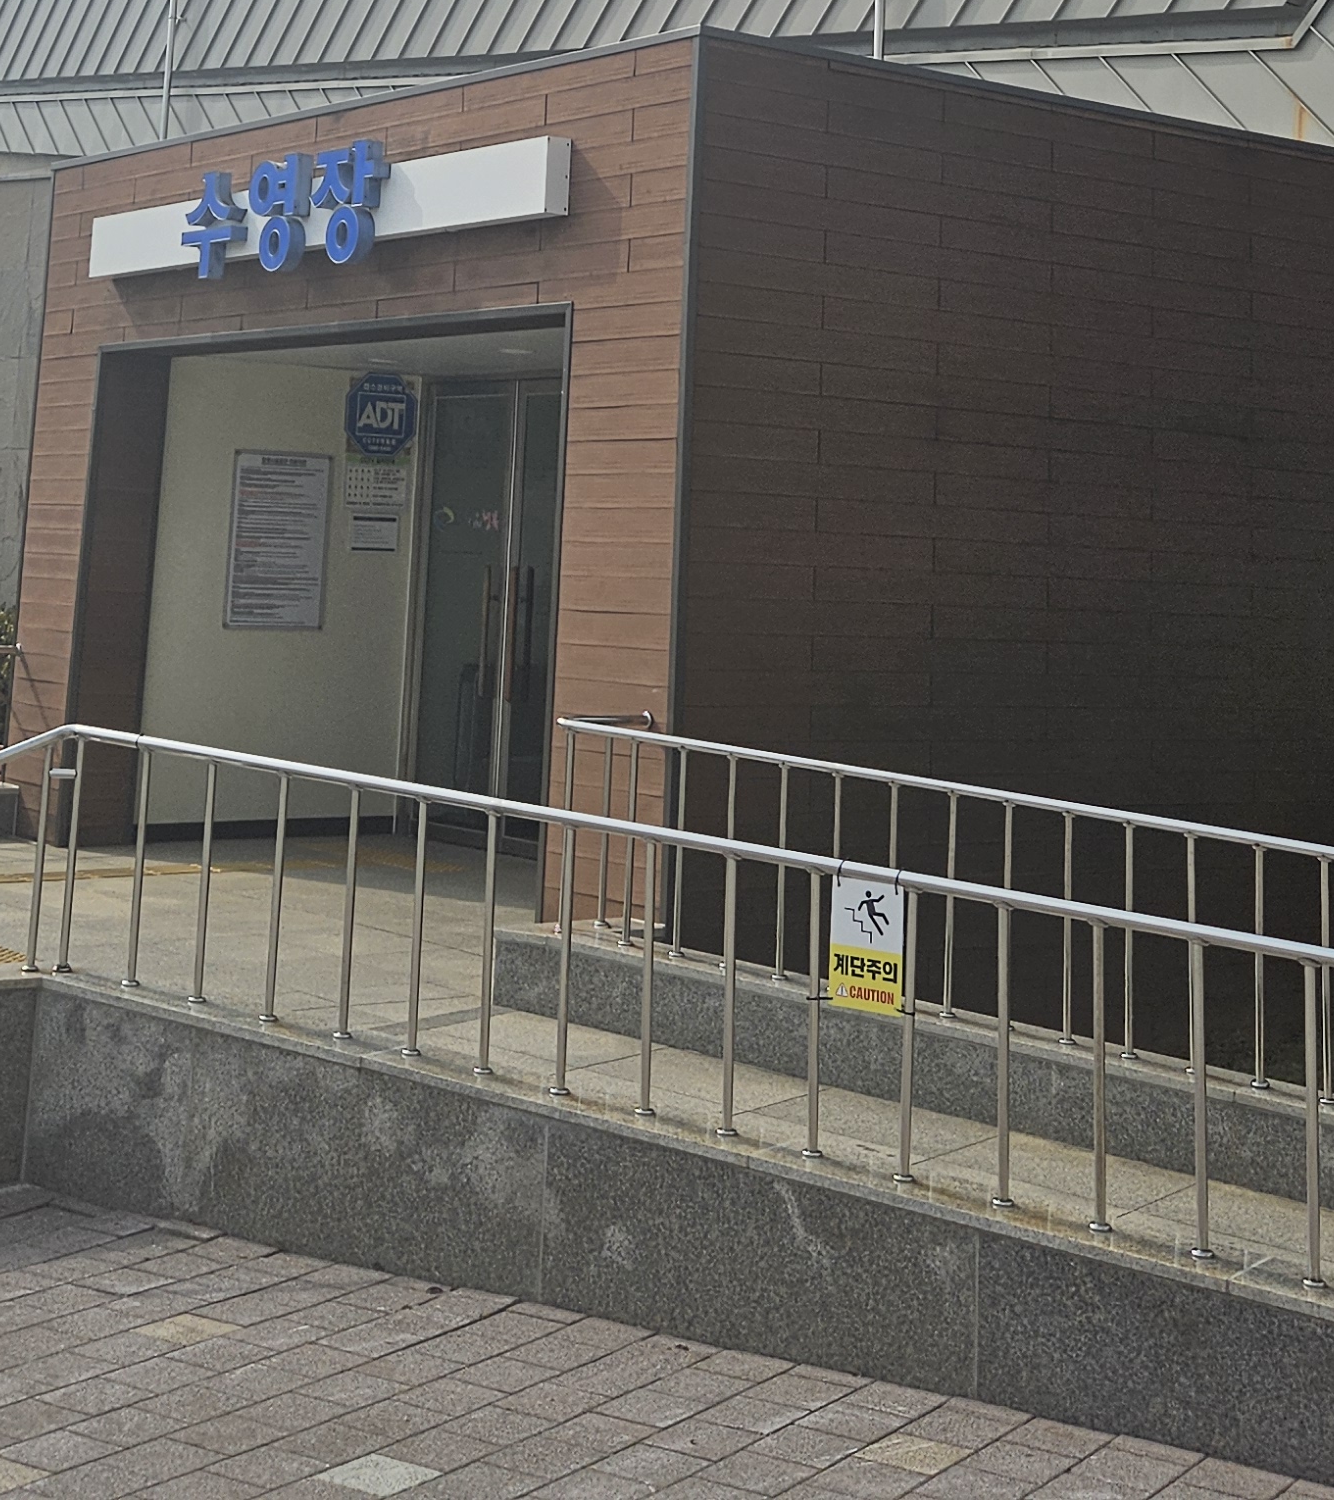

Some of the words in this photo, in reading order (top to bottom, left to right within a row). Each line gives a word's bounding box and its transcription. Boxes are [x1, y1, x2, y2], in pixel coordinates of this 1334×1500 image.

[181, 139, 389, 279] 수영장
[357, 401, 405, 430] ADT
[833, 953, 898, 984] 계단주의
[849, 985, 895, 1005] CAUTION
